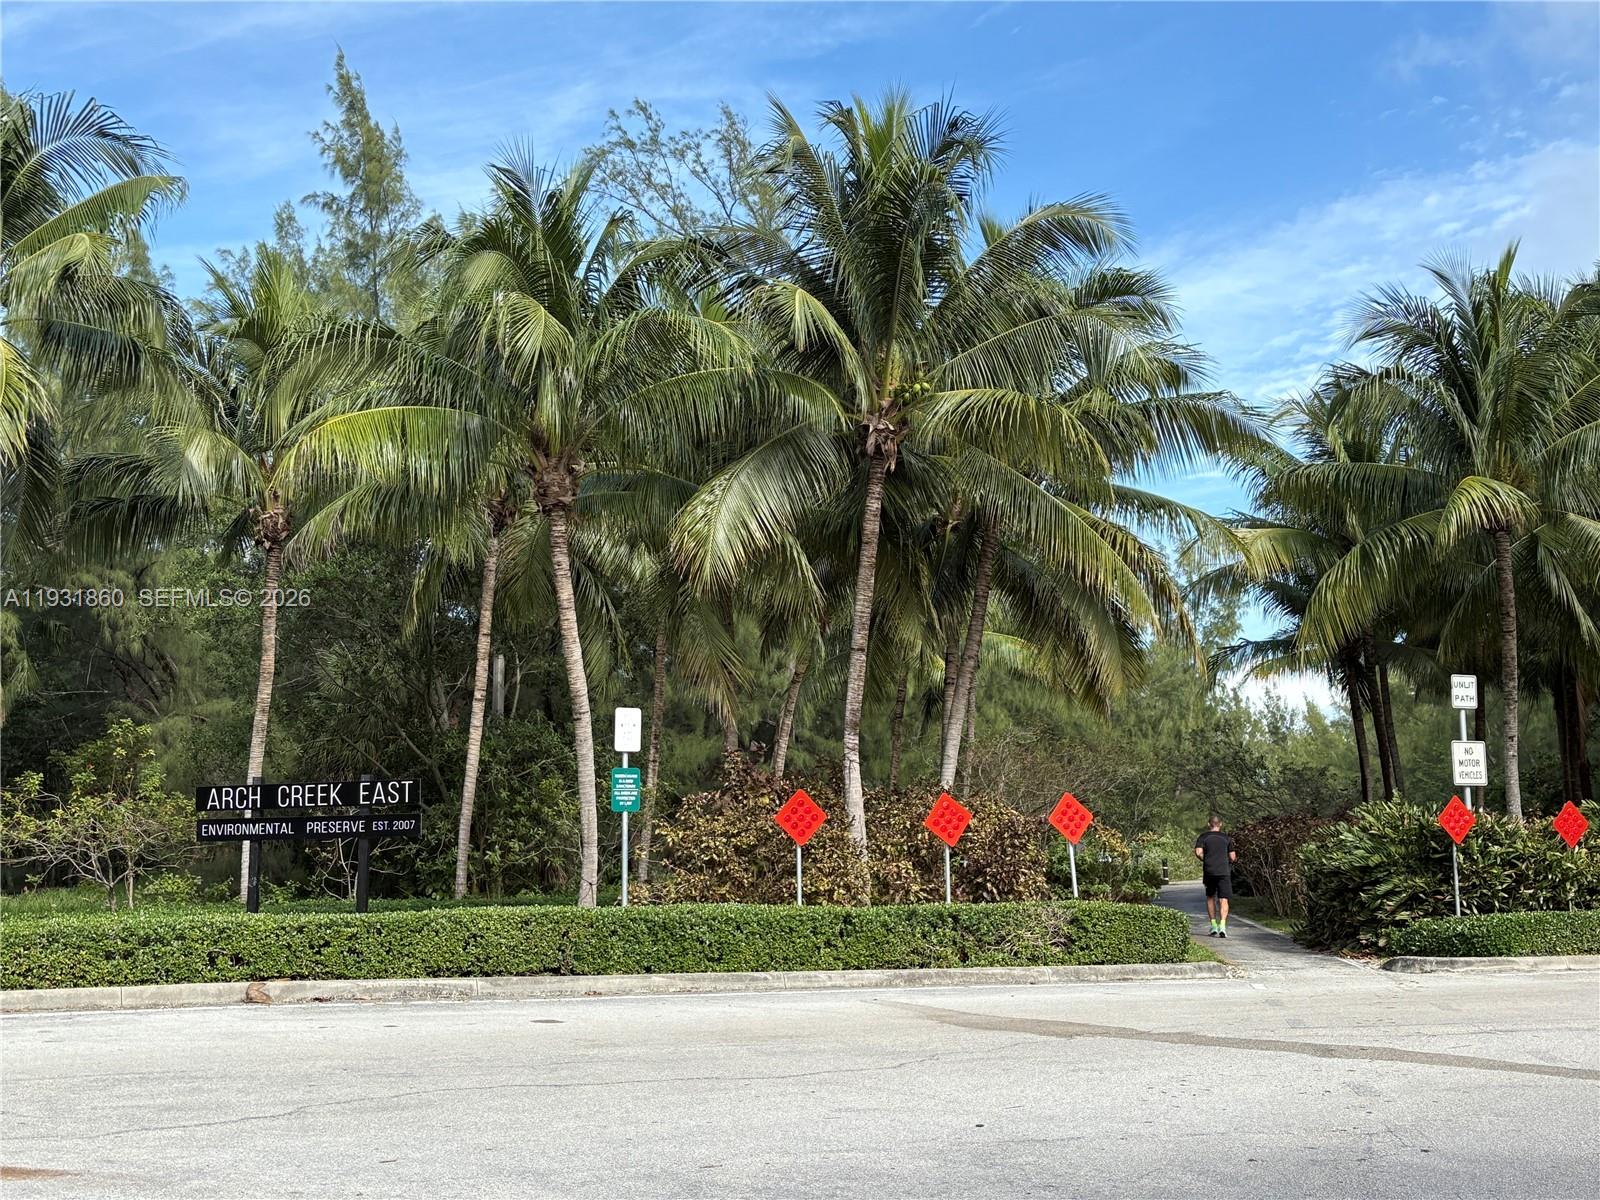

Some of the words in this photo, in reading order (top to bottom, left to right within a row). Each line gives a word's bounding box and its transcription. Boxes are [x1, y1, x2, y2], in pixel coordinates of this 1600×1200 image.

[1454, 695, 1475, 703] PATH
[1464, 747, 1474, 755] NO
[1458, 759, 1480, 767] MOTOR
[1458, 771, 1482, 779] VEHICLES
[206, 786, 261, 810] ARCH
[277, 783, 343, 808] CREEK
[359, 780, 414, 804] EAST
[201, 822, 295, 837] ENVIRONMENTAL
[306, 820, 366, 834] PRESERVE
[372, 821, 391, 831] EST.
[392, 819, 416, 831] 2007
